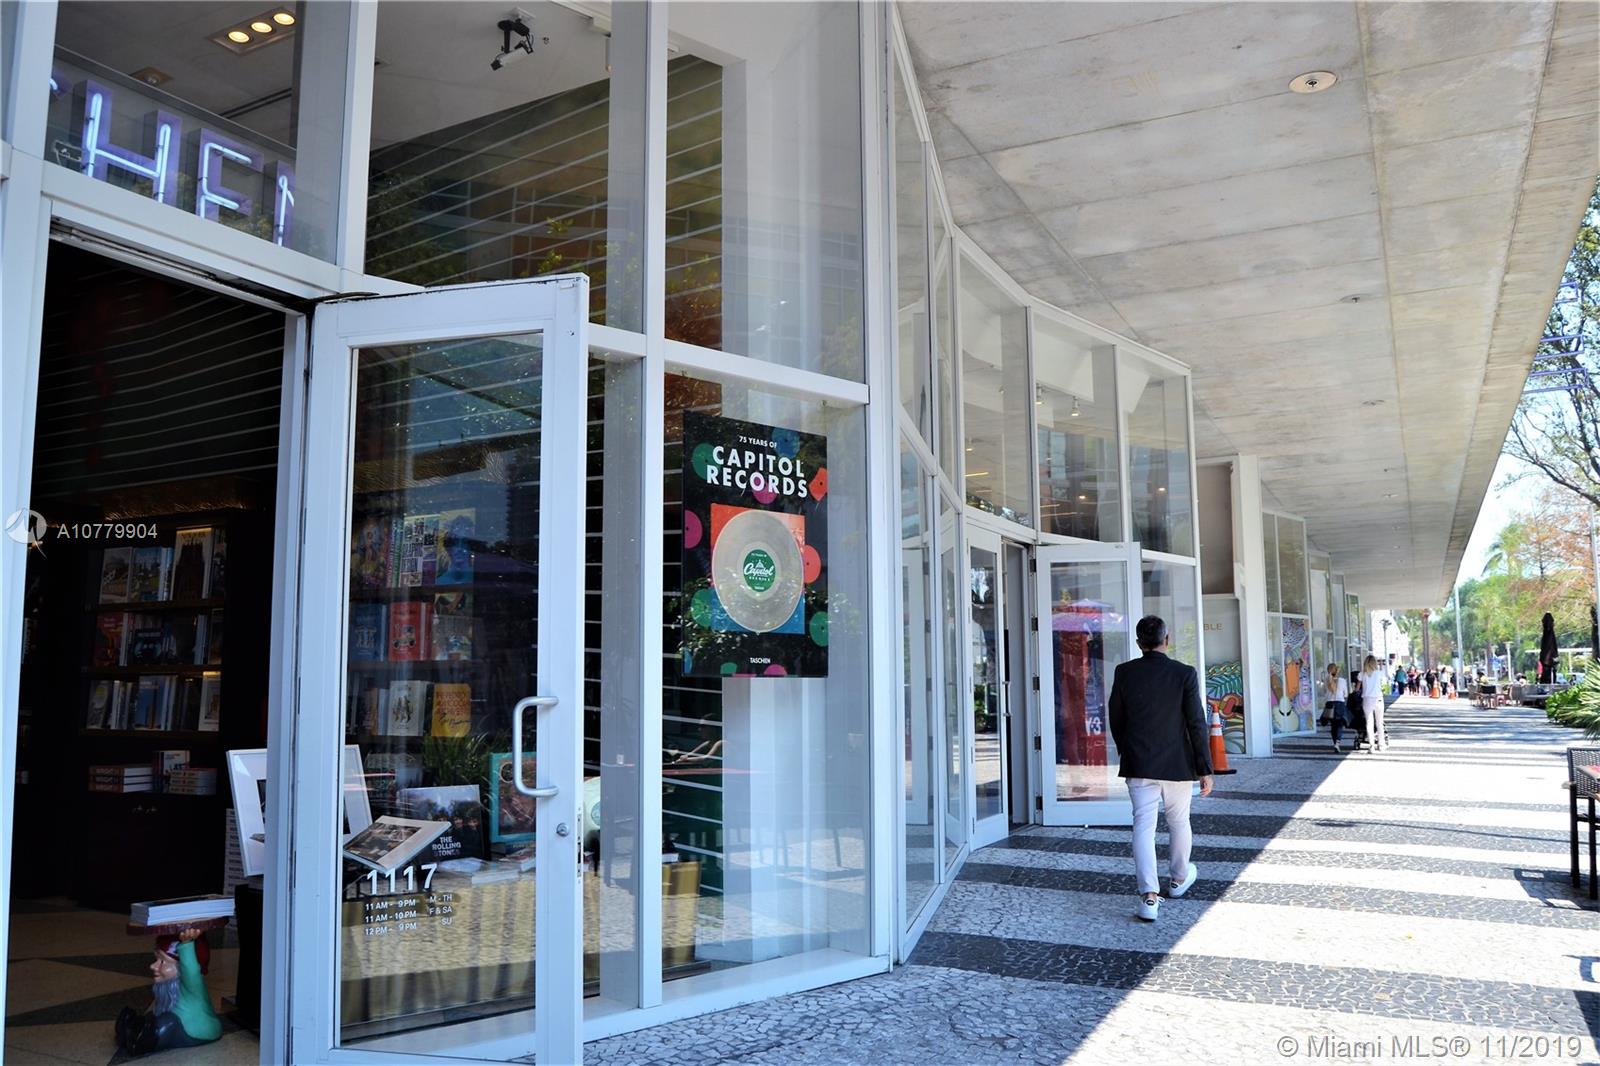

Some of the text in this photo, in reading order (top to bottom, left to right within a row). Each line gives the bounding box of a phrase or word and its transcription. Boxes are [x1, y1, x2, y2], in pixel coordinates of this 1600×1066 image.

[739, 436, 777, 449] 75 YEARS OF
[712, 445, 805, 478] CAPITOL
[706, 464, 808, 498] RECORDS
[432, 842, 462, 850] ROLLING
[439, 836, 453, 844] THE
[366, 863, 438, 896] 1117
[442, 894, 453, 902] TH
